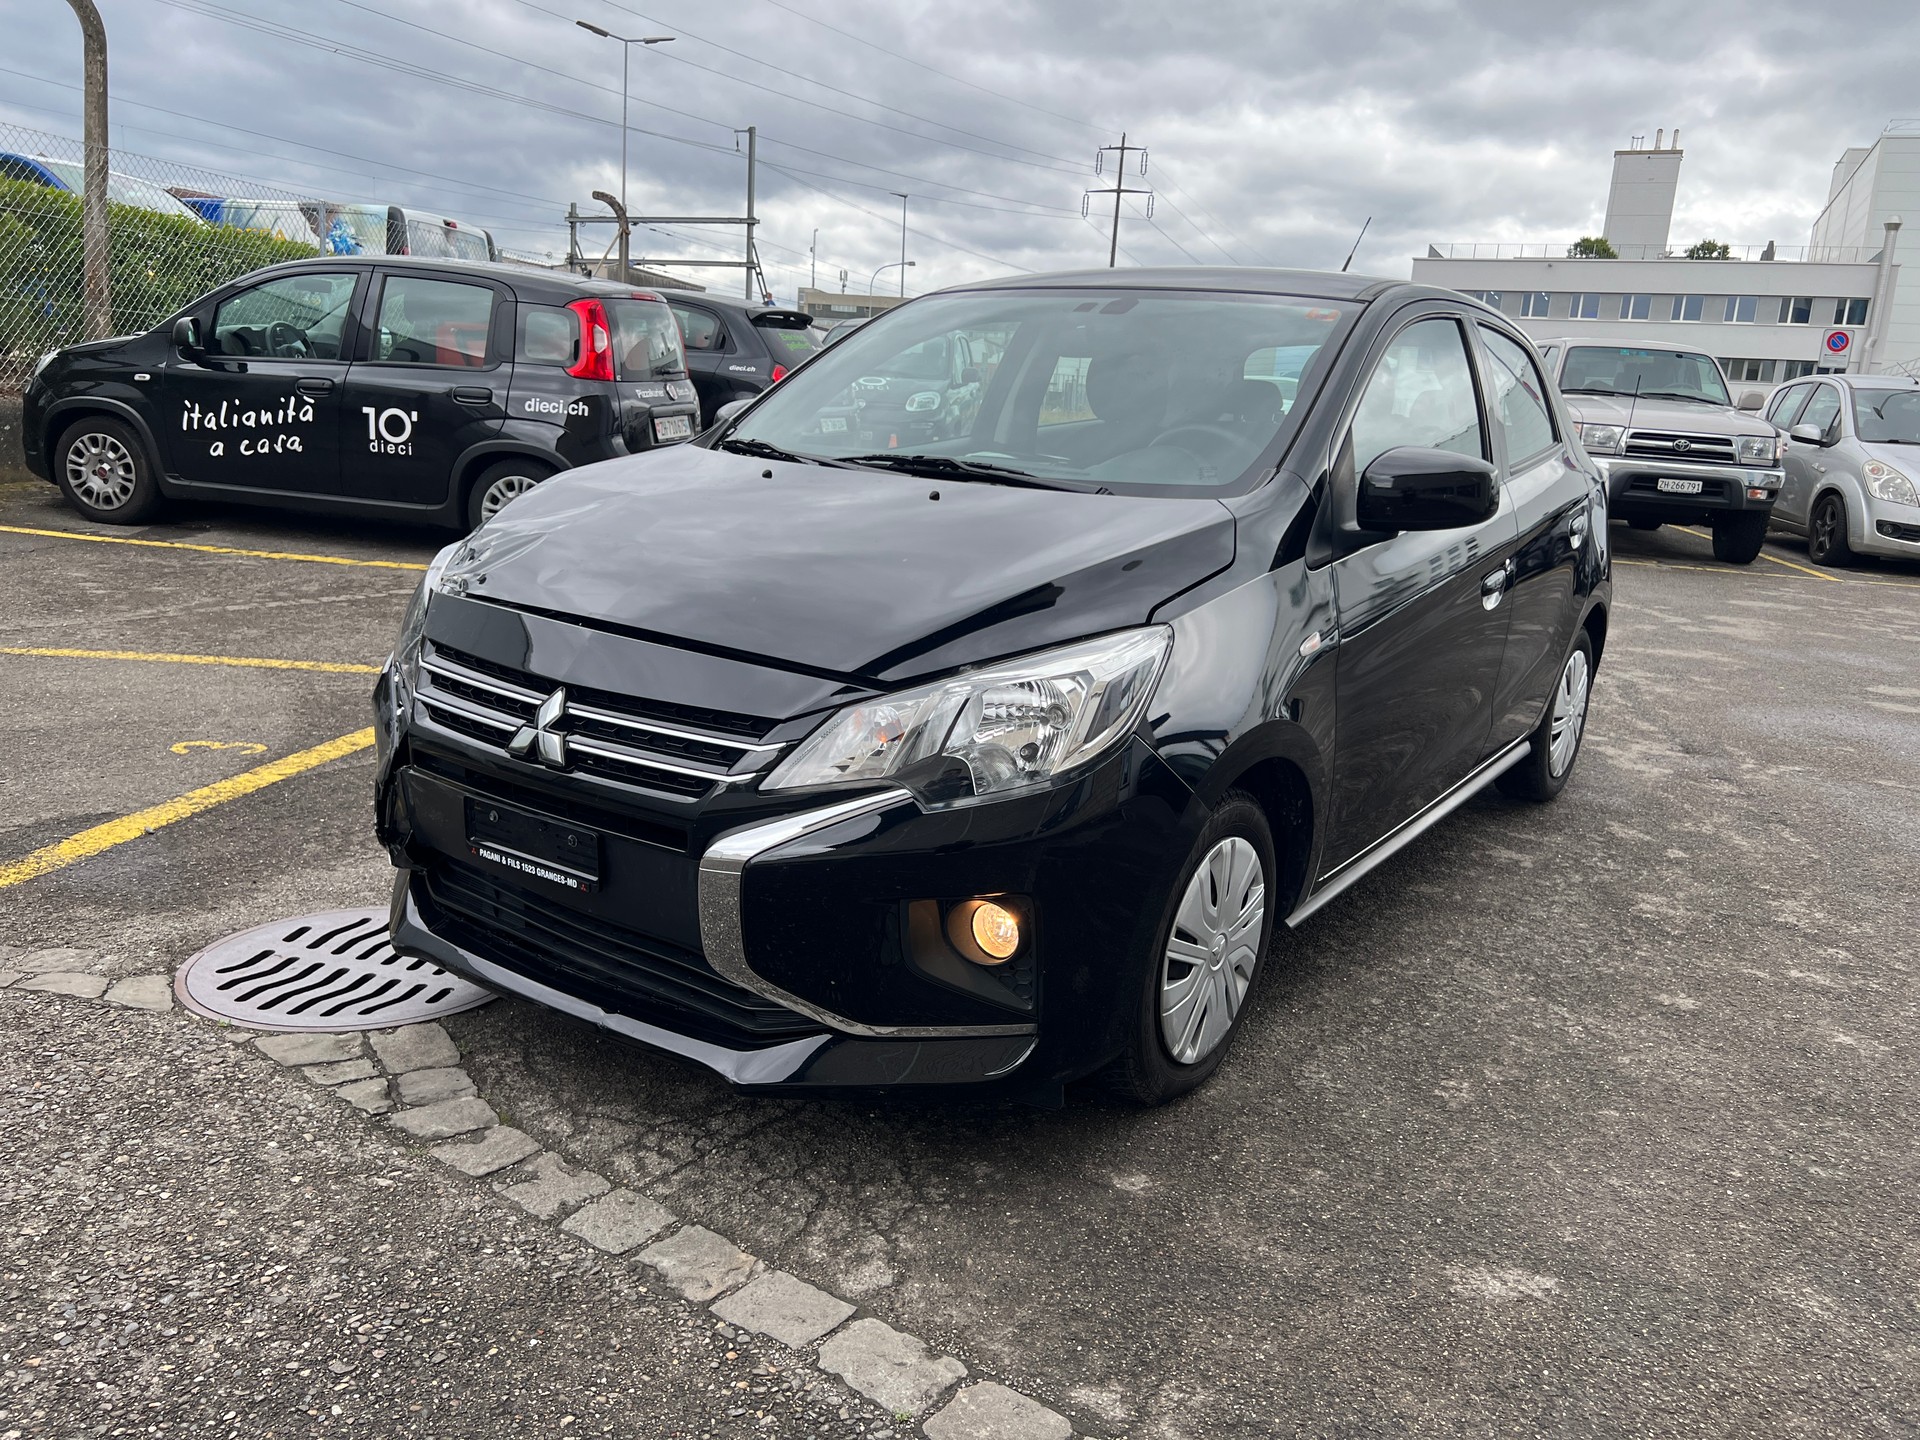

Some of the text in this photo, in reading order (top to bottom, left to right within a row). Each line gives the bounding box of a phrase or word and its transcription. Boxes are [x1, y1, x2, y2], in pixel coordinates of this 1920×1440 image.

[524, 398, 589, 417] dieci.ch
[209, 434, 303, 457] a casa
[369, 439, 413, 456] dieci
[479, 848, 578, 889] PAGANI & FILS 1523 GRANGES-MD
